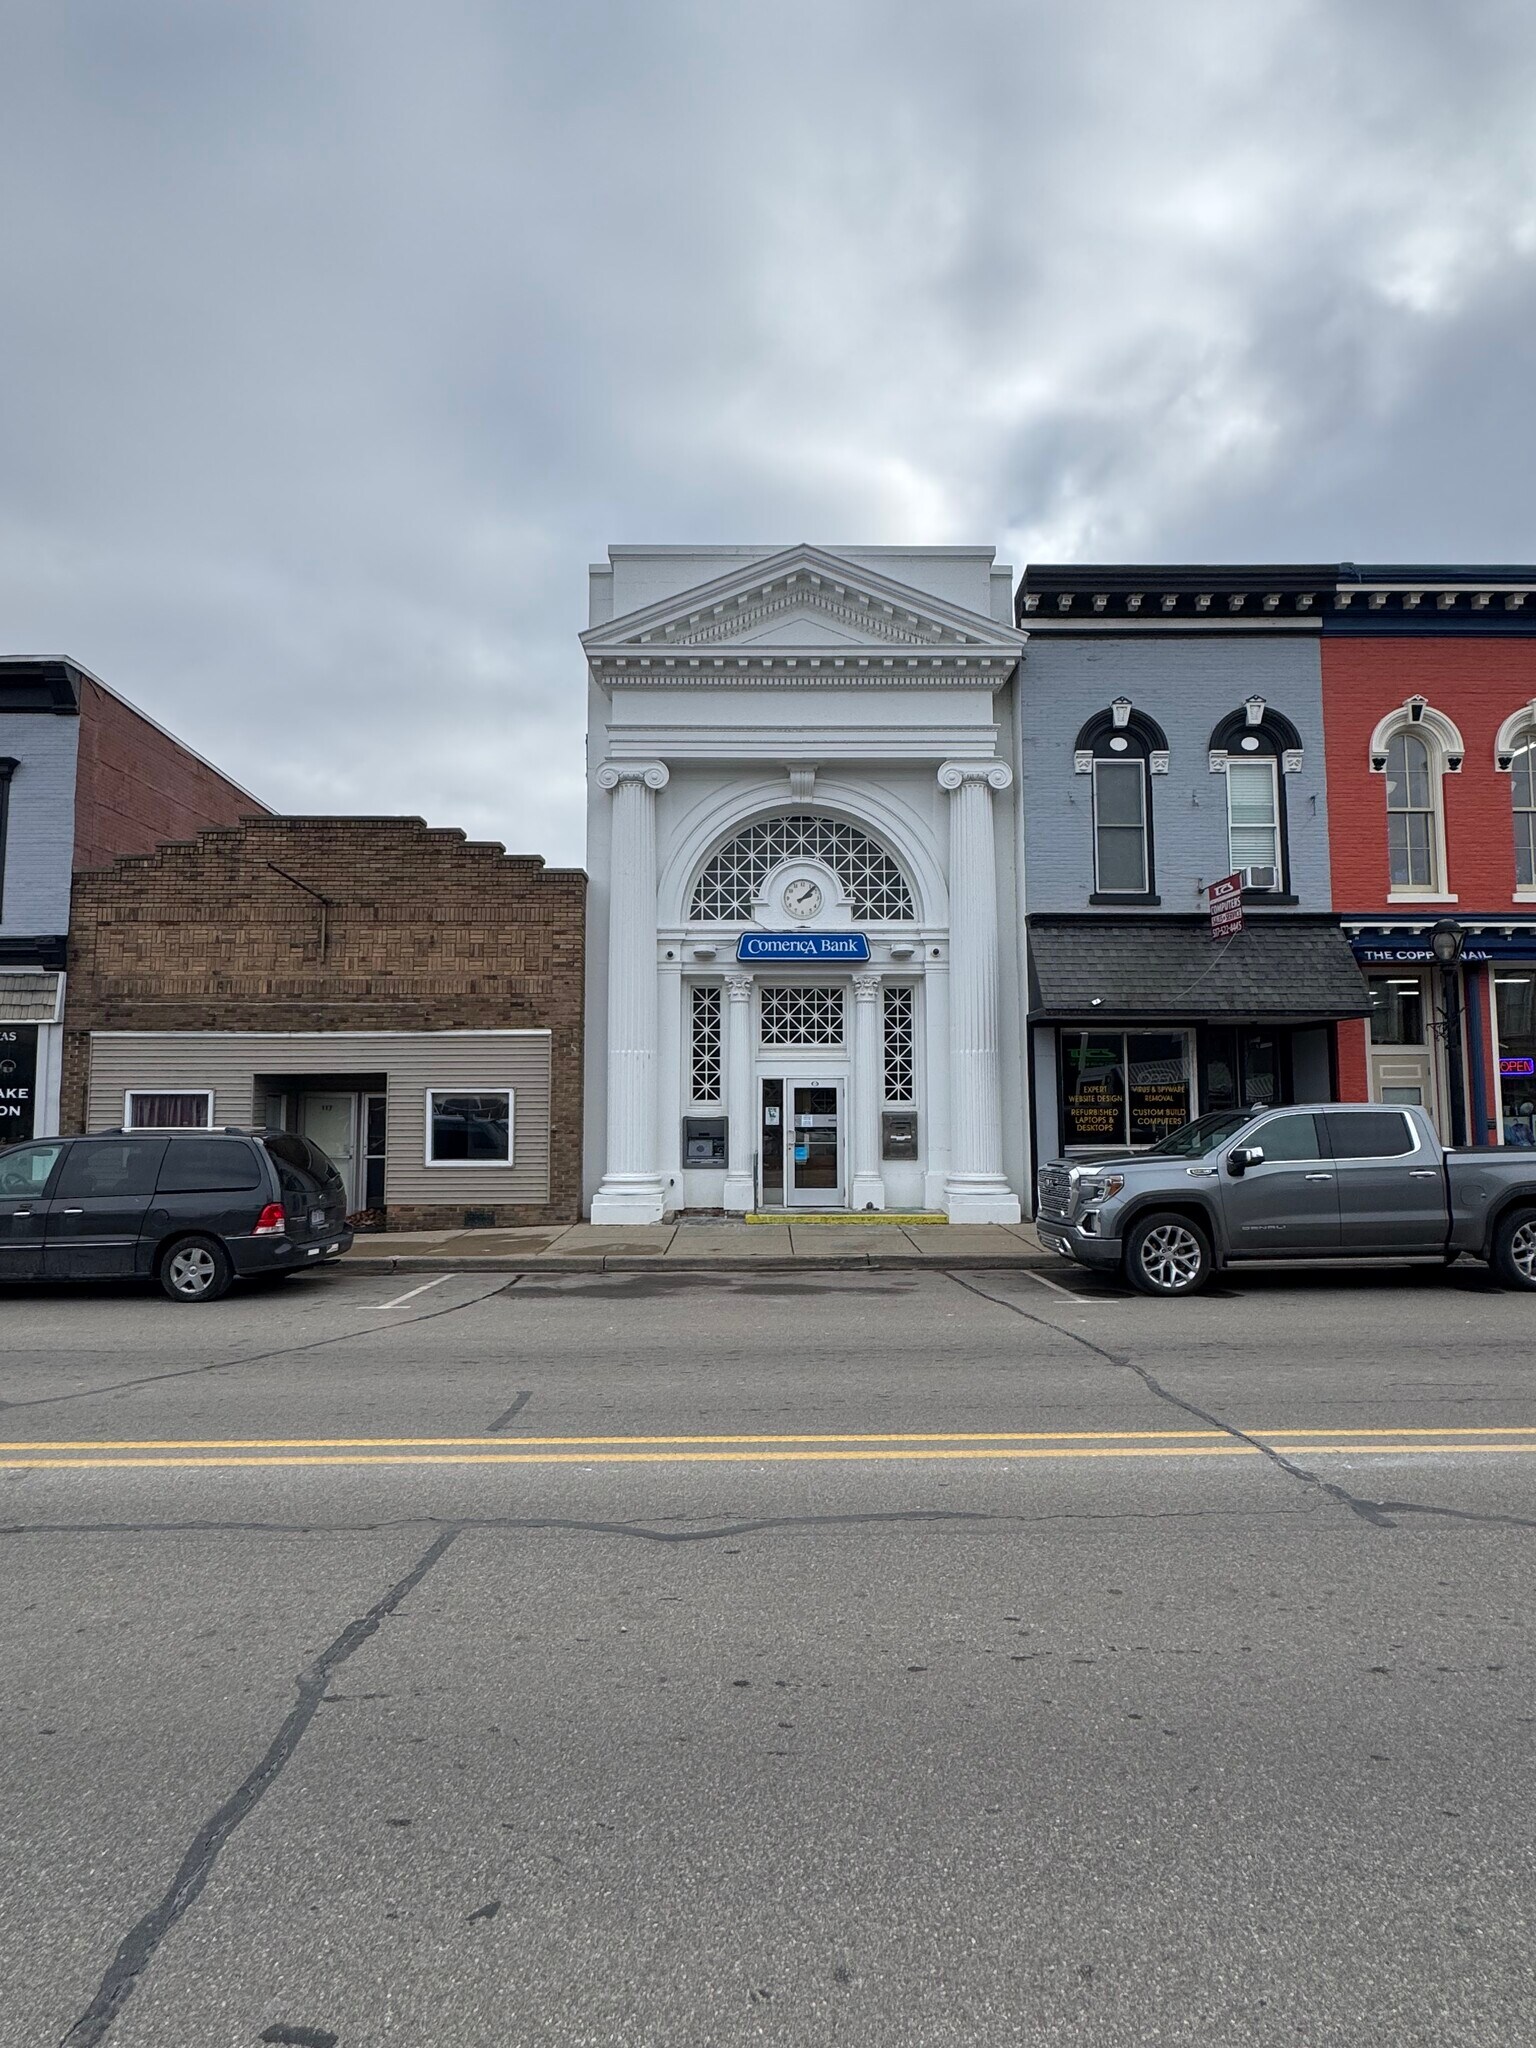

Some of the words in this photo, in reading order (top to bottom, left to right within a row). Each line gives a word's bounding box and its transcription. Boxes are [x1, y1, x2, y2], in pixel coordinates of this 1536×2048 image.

[1210, 896, 1241, 915] COMPUTERS
[821, 939, 859, 952] Bank
[1364, 951, 1393, 960] THE
[1396, 951, 1435, 960] COPP
[1500, 1061, 1532, 1072] OPEN
[1083, 1085, 1108, 1093] EXPERT
[1071, 1108, 1119, 1116] REFURBISHED
[1132, 1108, 1164, 1116] CUSTOM
[1166, 1108, 1187, 1116] BUILD
[1075, 1116, 1107, 1124] LAPTOPS
[1108, 1116, 1115, 1124] &
[1137, 1117, 1182, 1125] COMPUTERS
[1076, 1124, 1114, 1132] DESKTOPS
